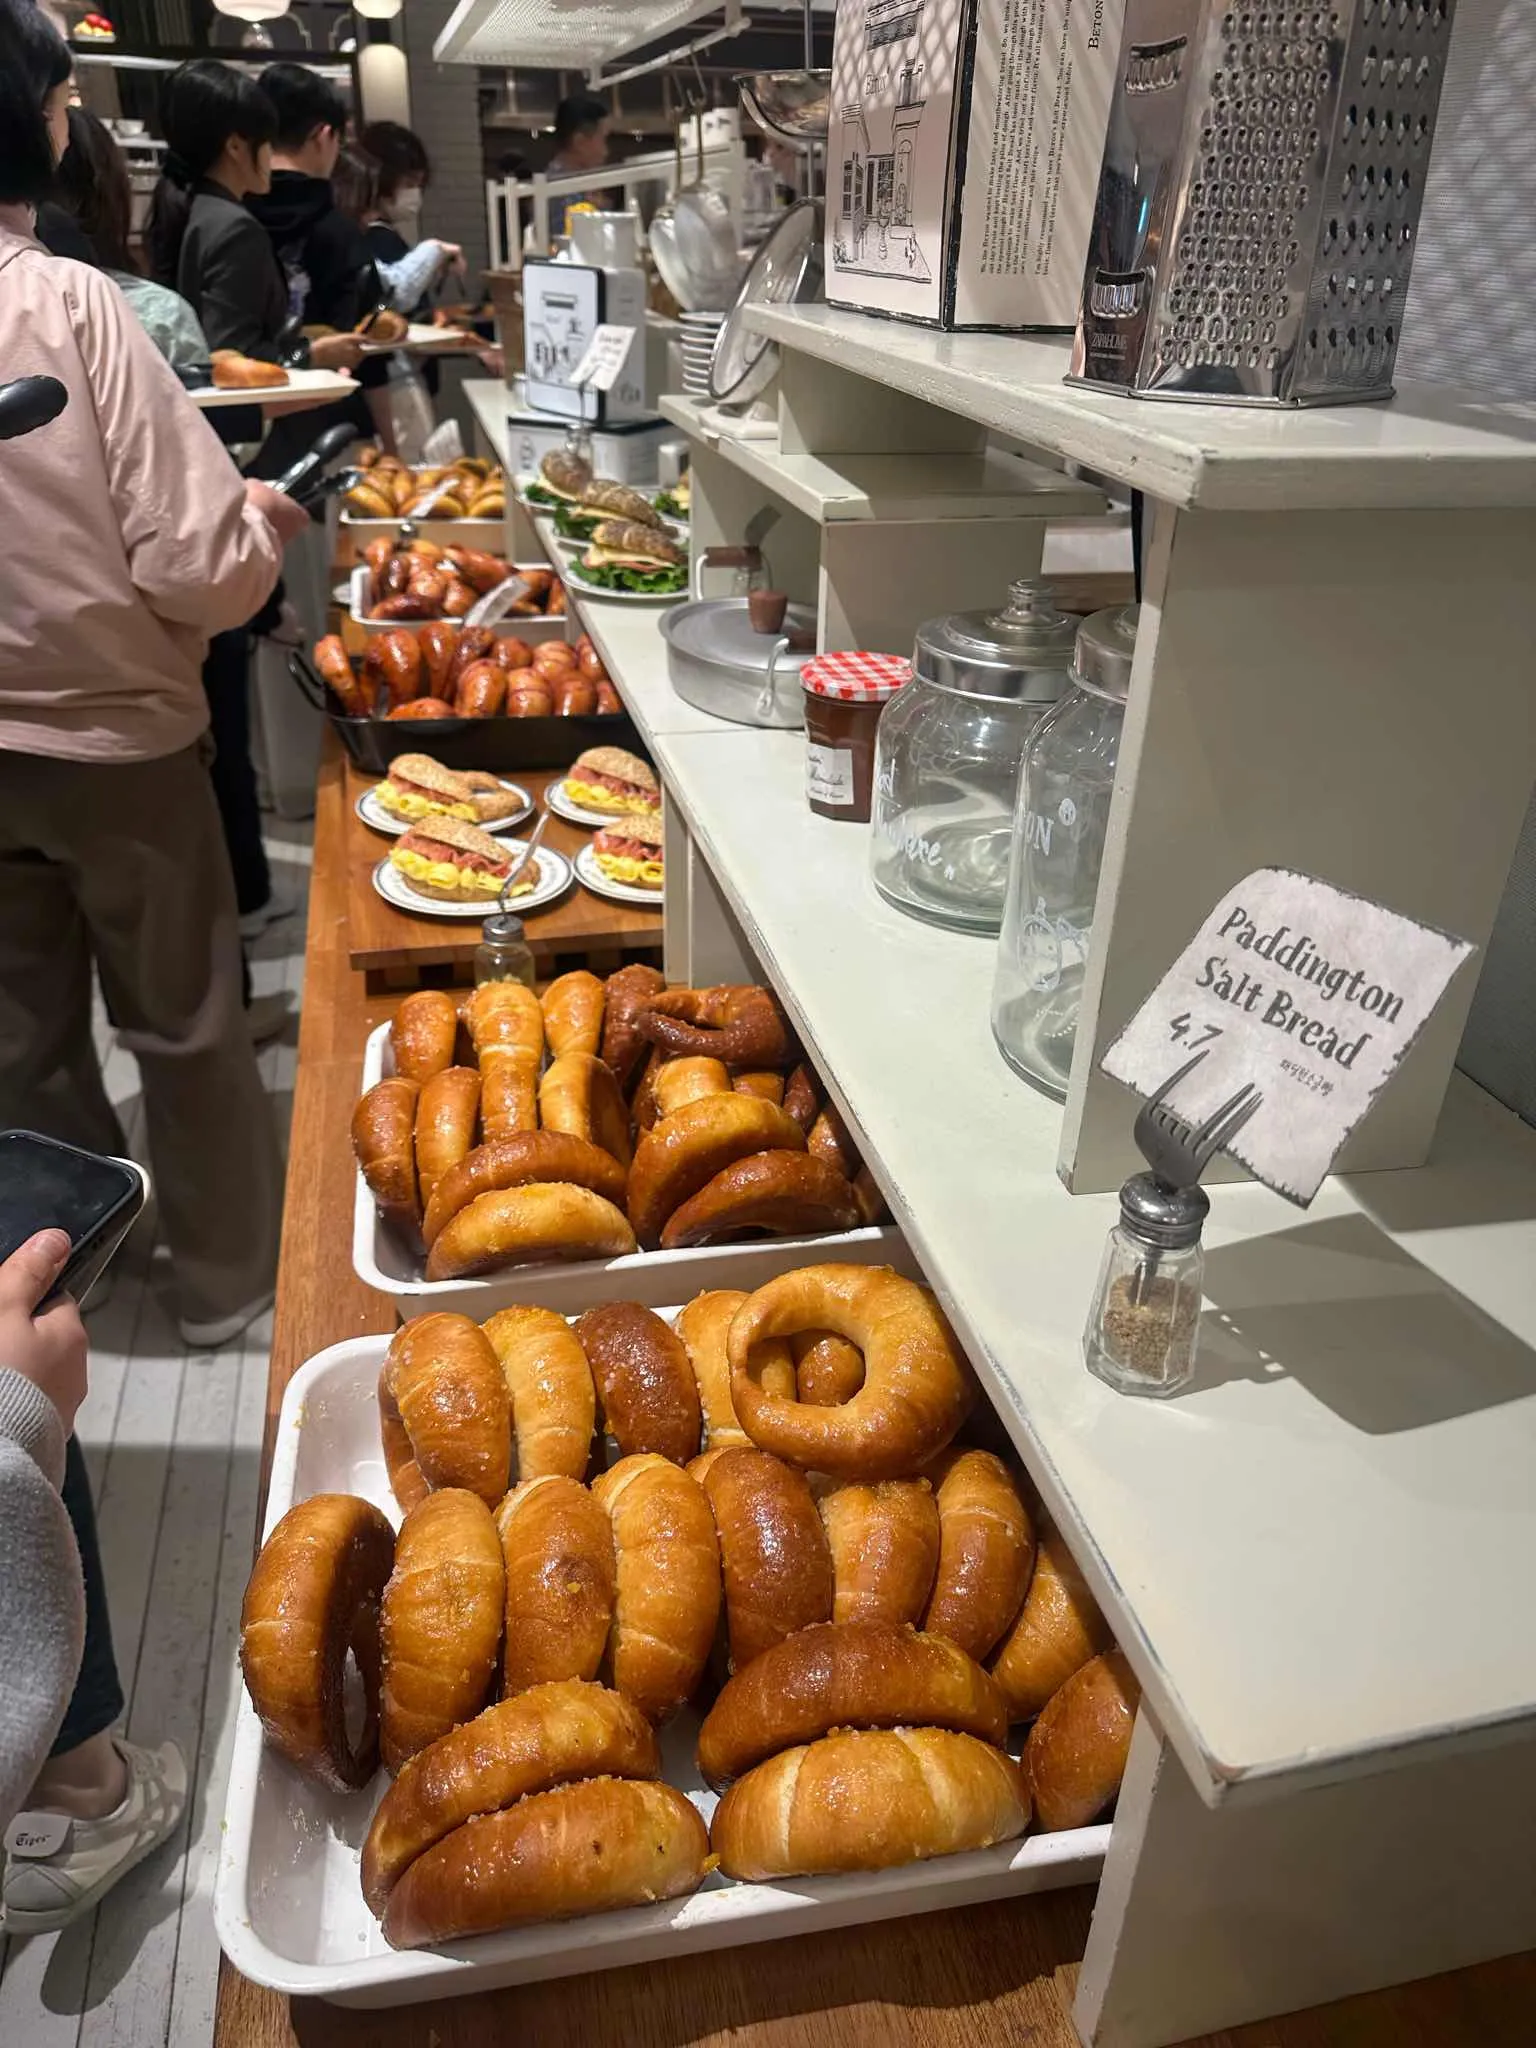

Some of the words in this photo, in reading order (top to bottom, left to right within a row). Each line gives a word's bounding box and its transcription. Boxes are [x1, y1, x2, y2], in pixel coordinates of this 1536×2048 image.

[1018, 188, 1026, 219] maintain
[1024, 133, 1032, 159] texture
[1036, 14, 1044, 43] because
[1060, 86, 1070, 130] experienced
[985, 197, 993, 221] wanted
[994, 75, 1004, 129] mouthwatering
[1037, 242, 1045, 262] highly
[1039, 201, 1049, 240] recommend
[1217, 907, 1404, 1023] Paddington
[1169, 1012, 1223, 1050] 4.7
[1196, 956, 1263, 1013] Salt
[1262, 990, 1372, 1070] Bread
